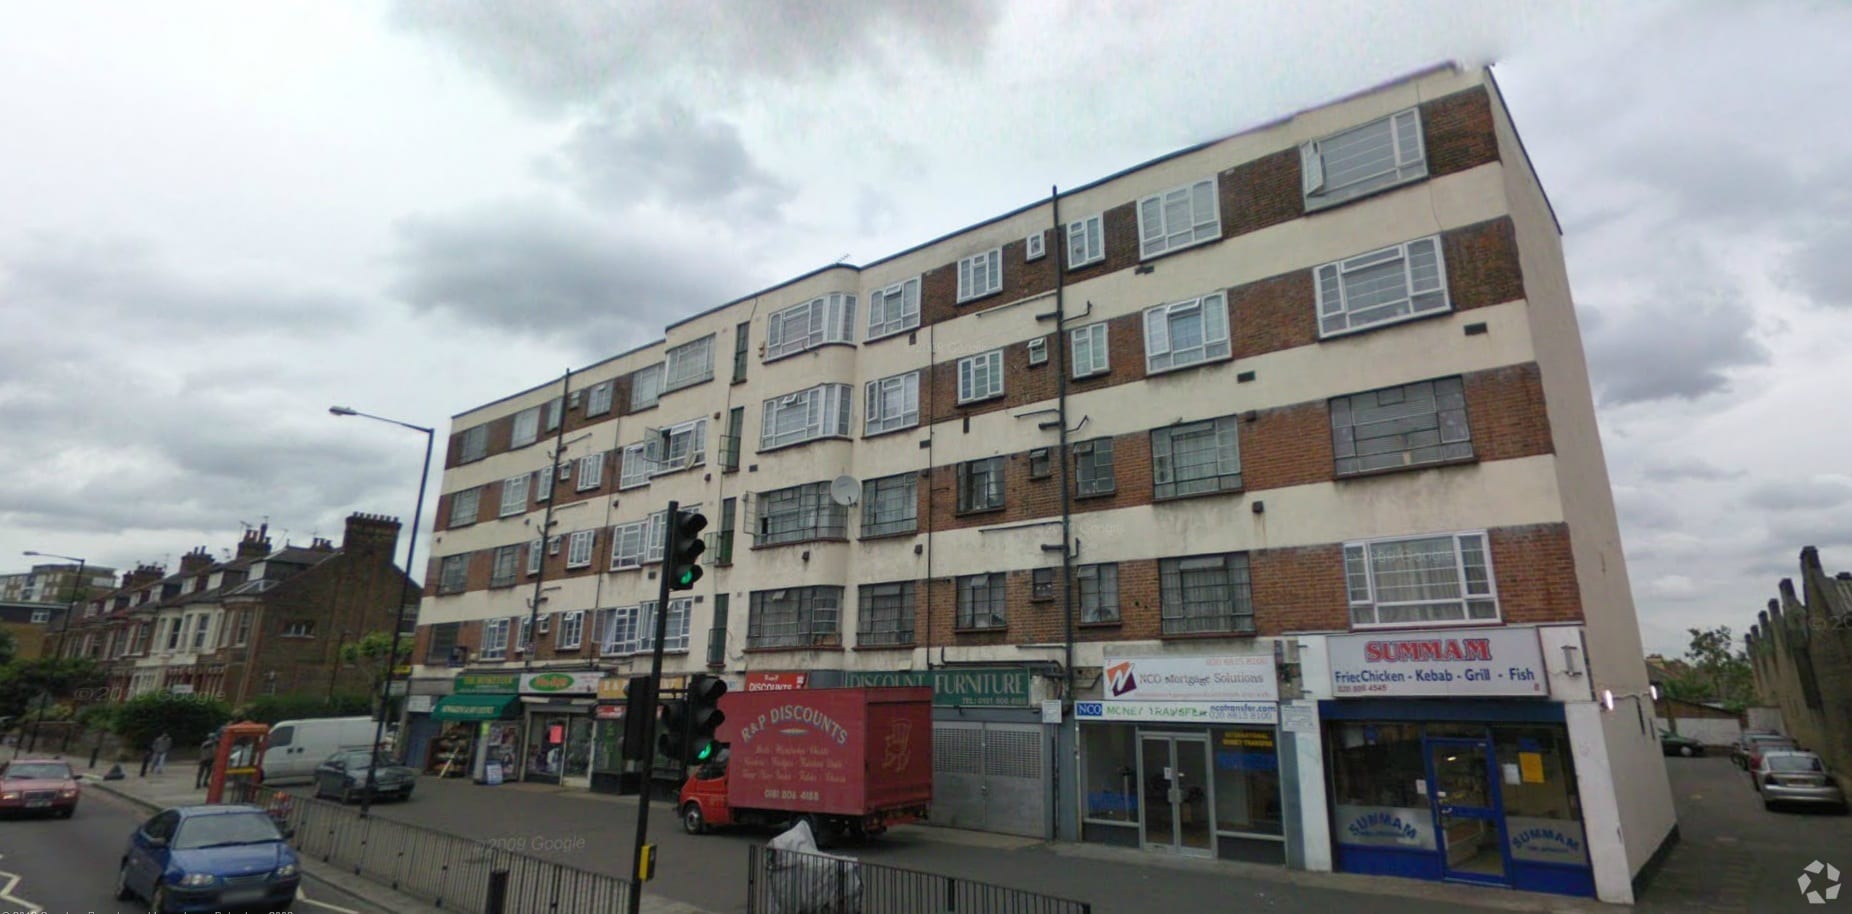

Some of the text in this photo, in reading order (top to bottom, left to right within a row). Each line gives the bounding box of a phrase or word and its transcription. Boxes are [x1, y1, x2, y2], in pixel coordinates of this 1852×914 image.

[1365, 638, 1492, 662] SUMMAM
[850, 673, 1024, 694] DISCOUNT FURNITURE
[1139, 673, 1162, 684] NCO
[1214, 672, 1264, 684] Solutions
[1361, 670, 1404, 682] Chicken
[1416, 670, 1452, 682] Kebab
[1464, 668, 1490, 681] Grill
[1509, 668, 1535, 680] Fish
[1078, 705, 1102, 715] NCO
[1210, 704, 1276, 712] ncotransfer.com
[741, 704, 848, 745] R&P DISCOUNTS
[1348, 812, 1416, 839] SUMMAM
[1512, 828, 1580, 850] SUMMAM
